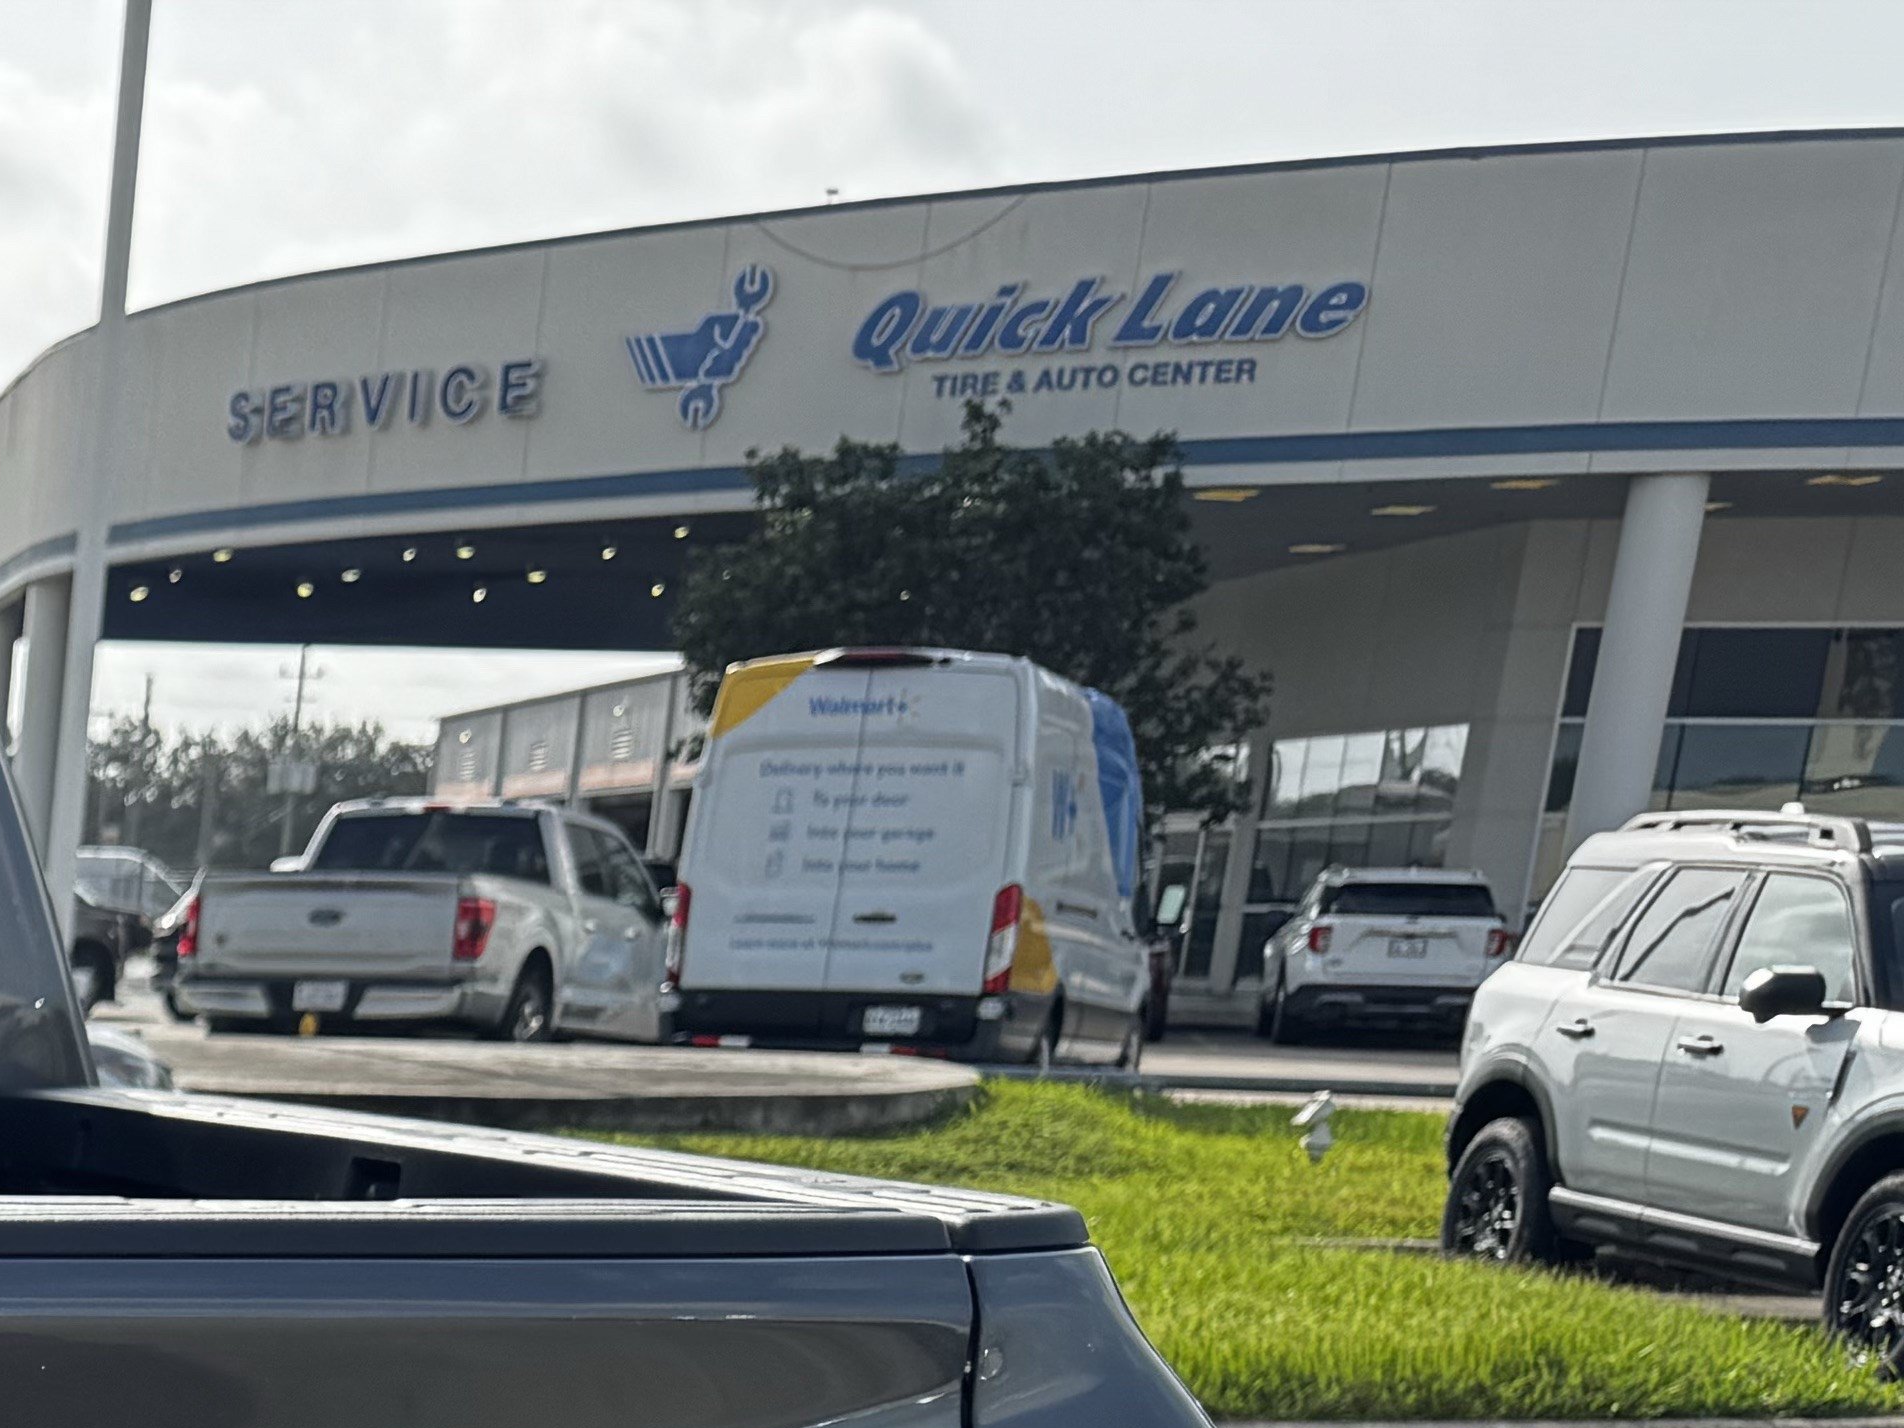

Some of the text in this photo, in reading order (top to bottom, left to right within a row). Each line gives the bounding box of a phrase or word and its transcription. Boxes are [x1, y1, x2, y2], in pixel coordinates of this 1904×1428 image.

[853, 270, 1369, 373] Quick Lane
[227, 358, 540, 444] SERVICE
[933, 358, 1257, 398] TIRE & AUTO CENTER
